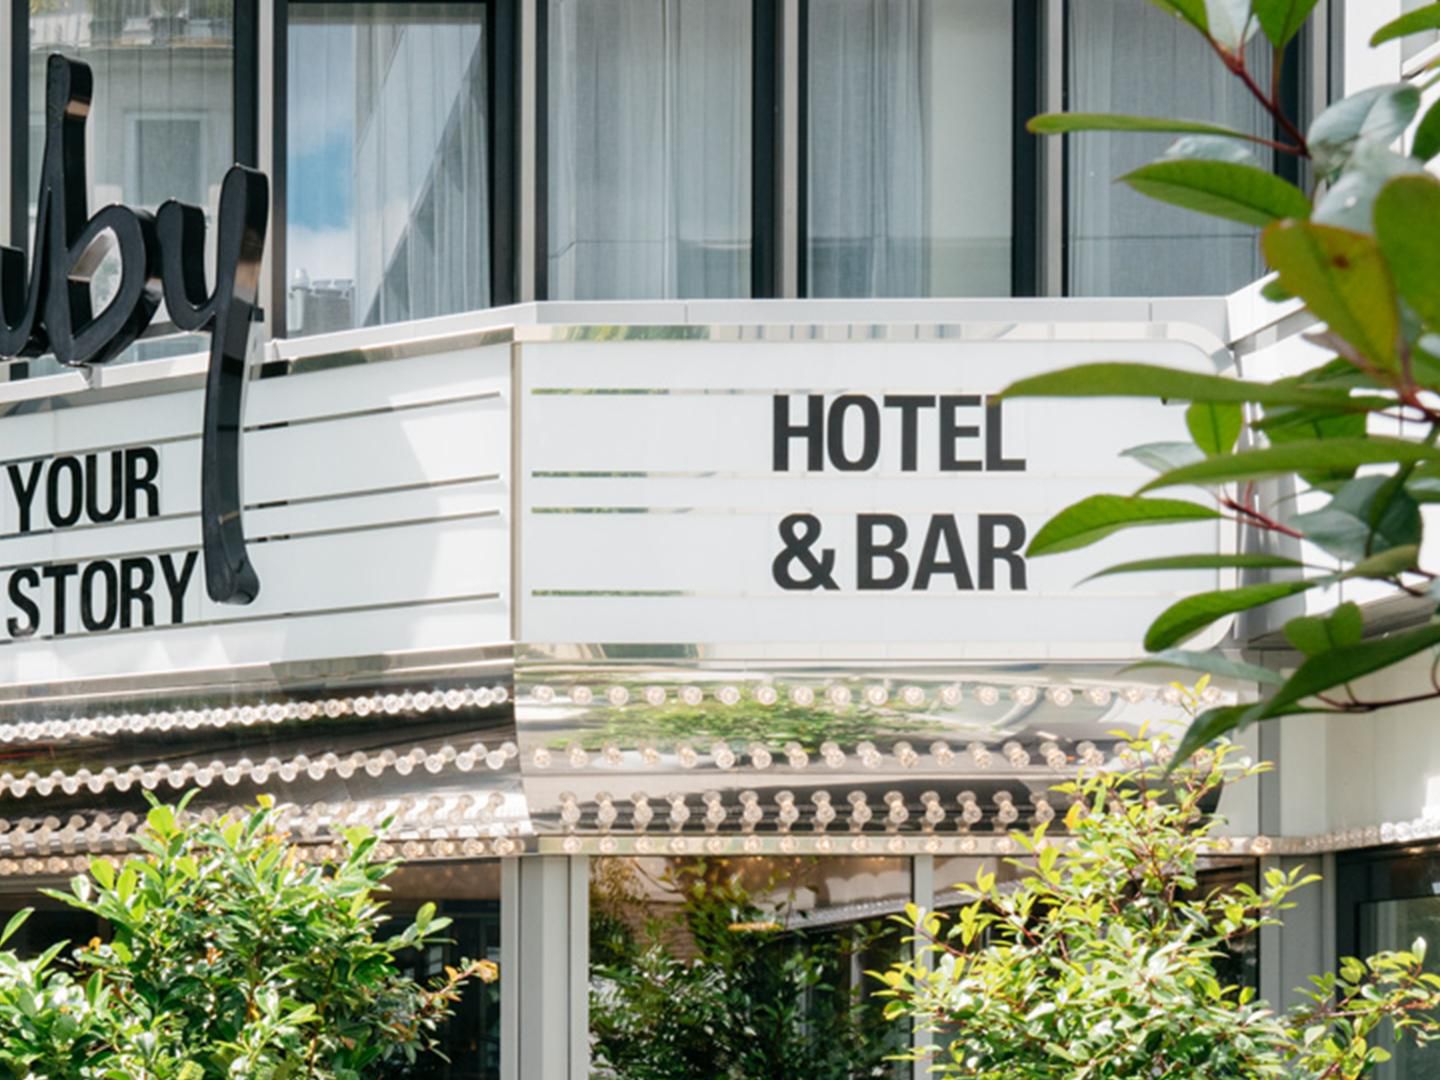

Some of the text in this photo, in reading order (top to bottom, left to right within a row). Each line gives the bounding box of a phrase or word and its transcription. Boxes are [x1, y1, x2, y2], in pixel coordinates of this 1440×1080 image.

[772, 394, 1026, 472] HOTEL
[7, 447, 160, 533] YOUR
[771, 513, 1028, 591] & BAR
[6, 551, 199, 638] STORY
